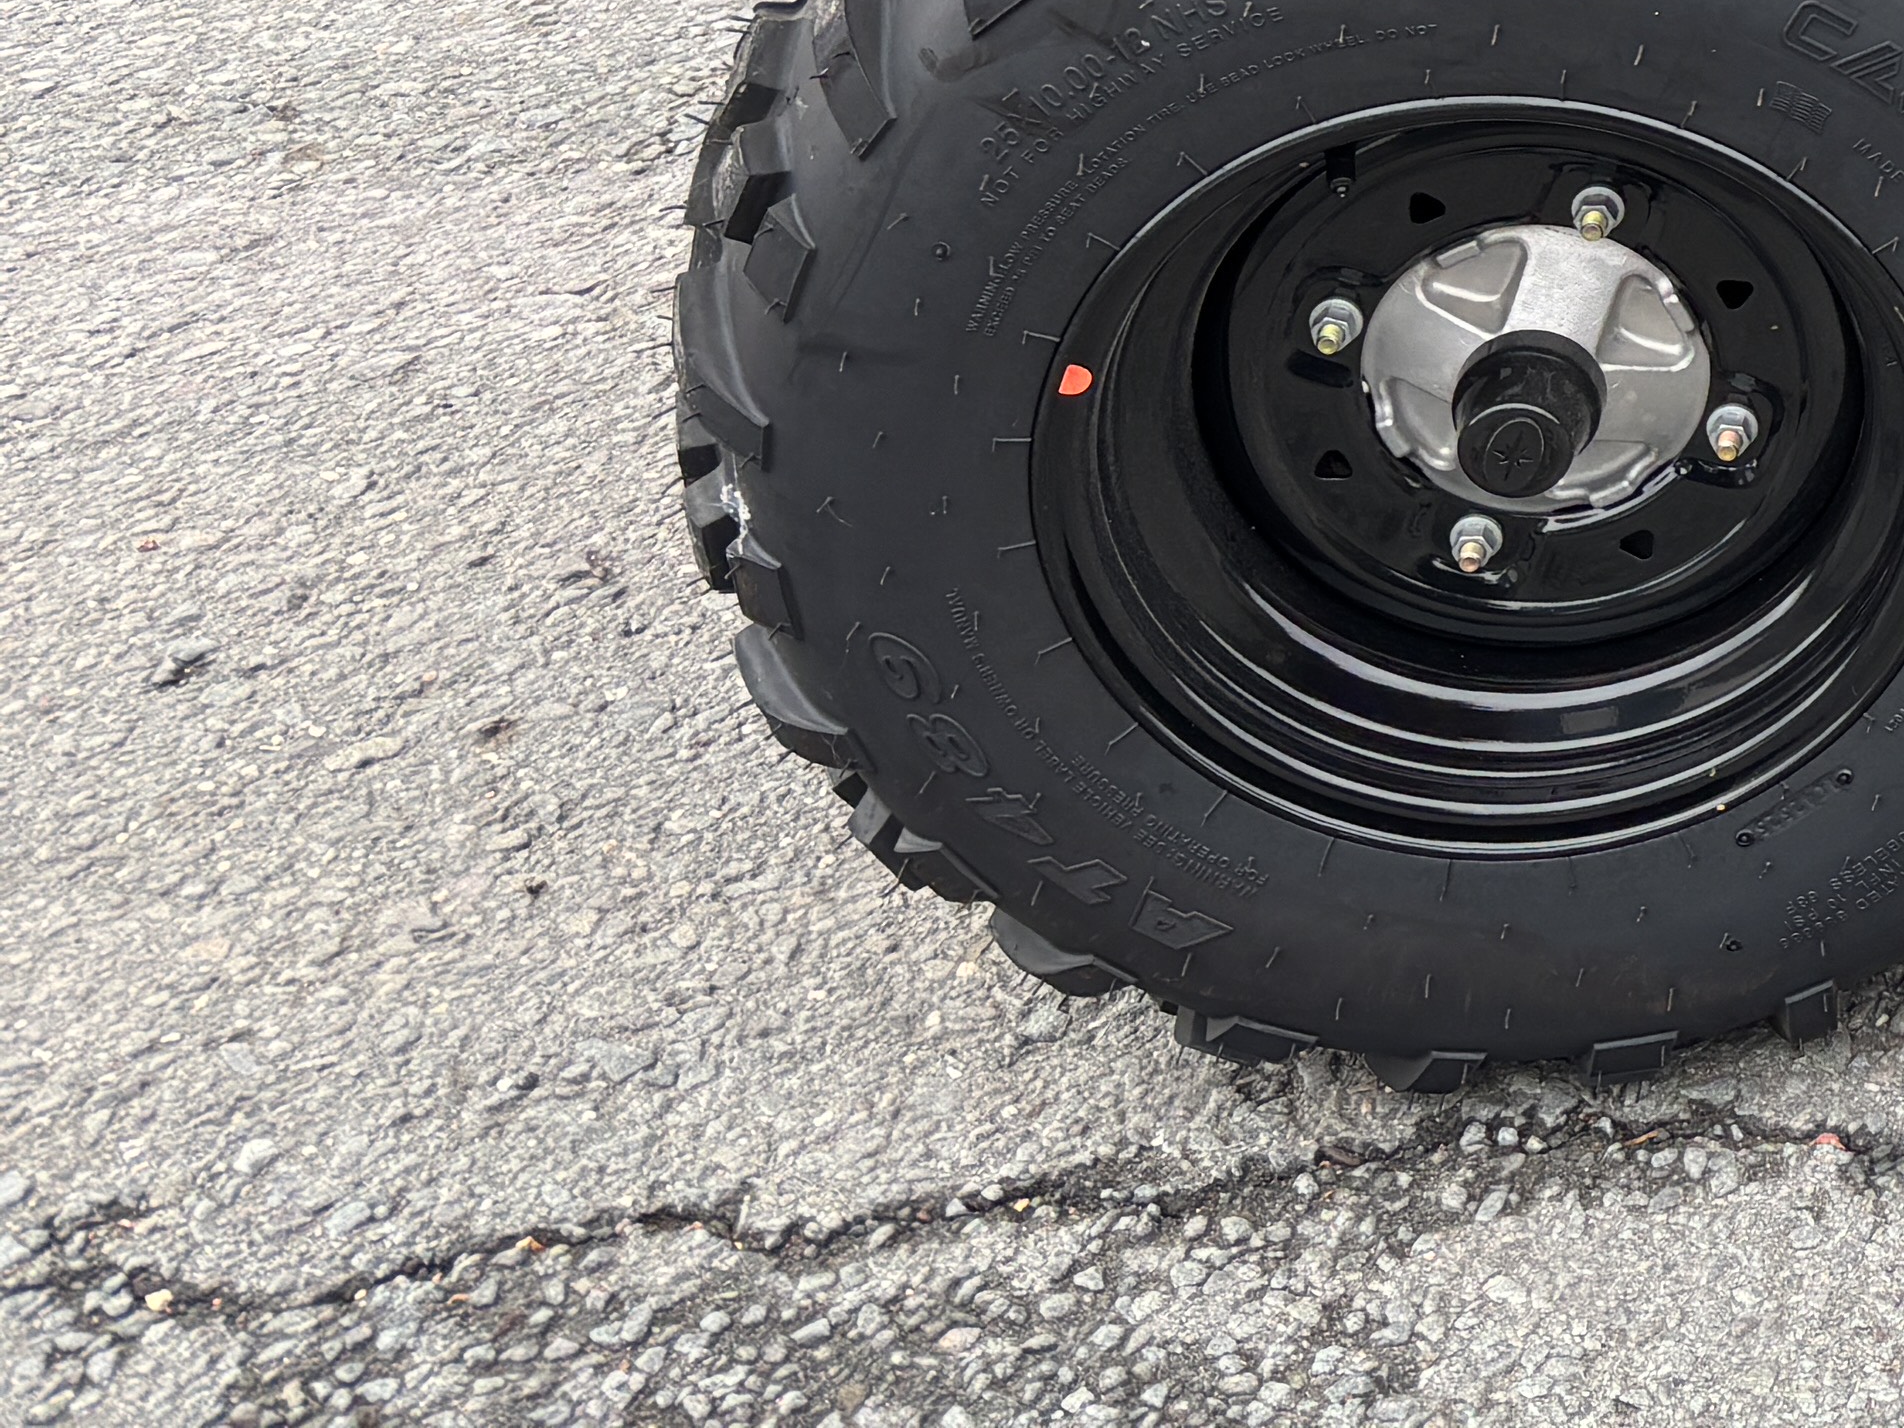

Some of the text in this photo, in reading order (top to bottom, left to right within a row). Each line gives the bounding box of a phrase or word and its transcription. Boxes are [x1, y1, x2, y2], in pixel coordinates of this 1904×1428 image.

[979, 5, 1285, 208] NOT FOR HIGHWAY SERVICE
